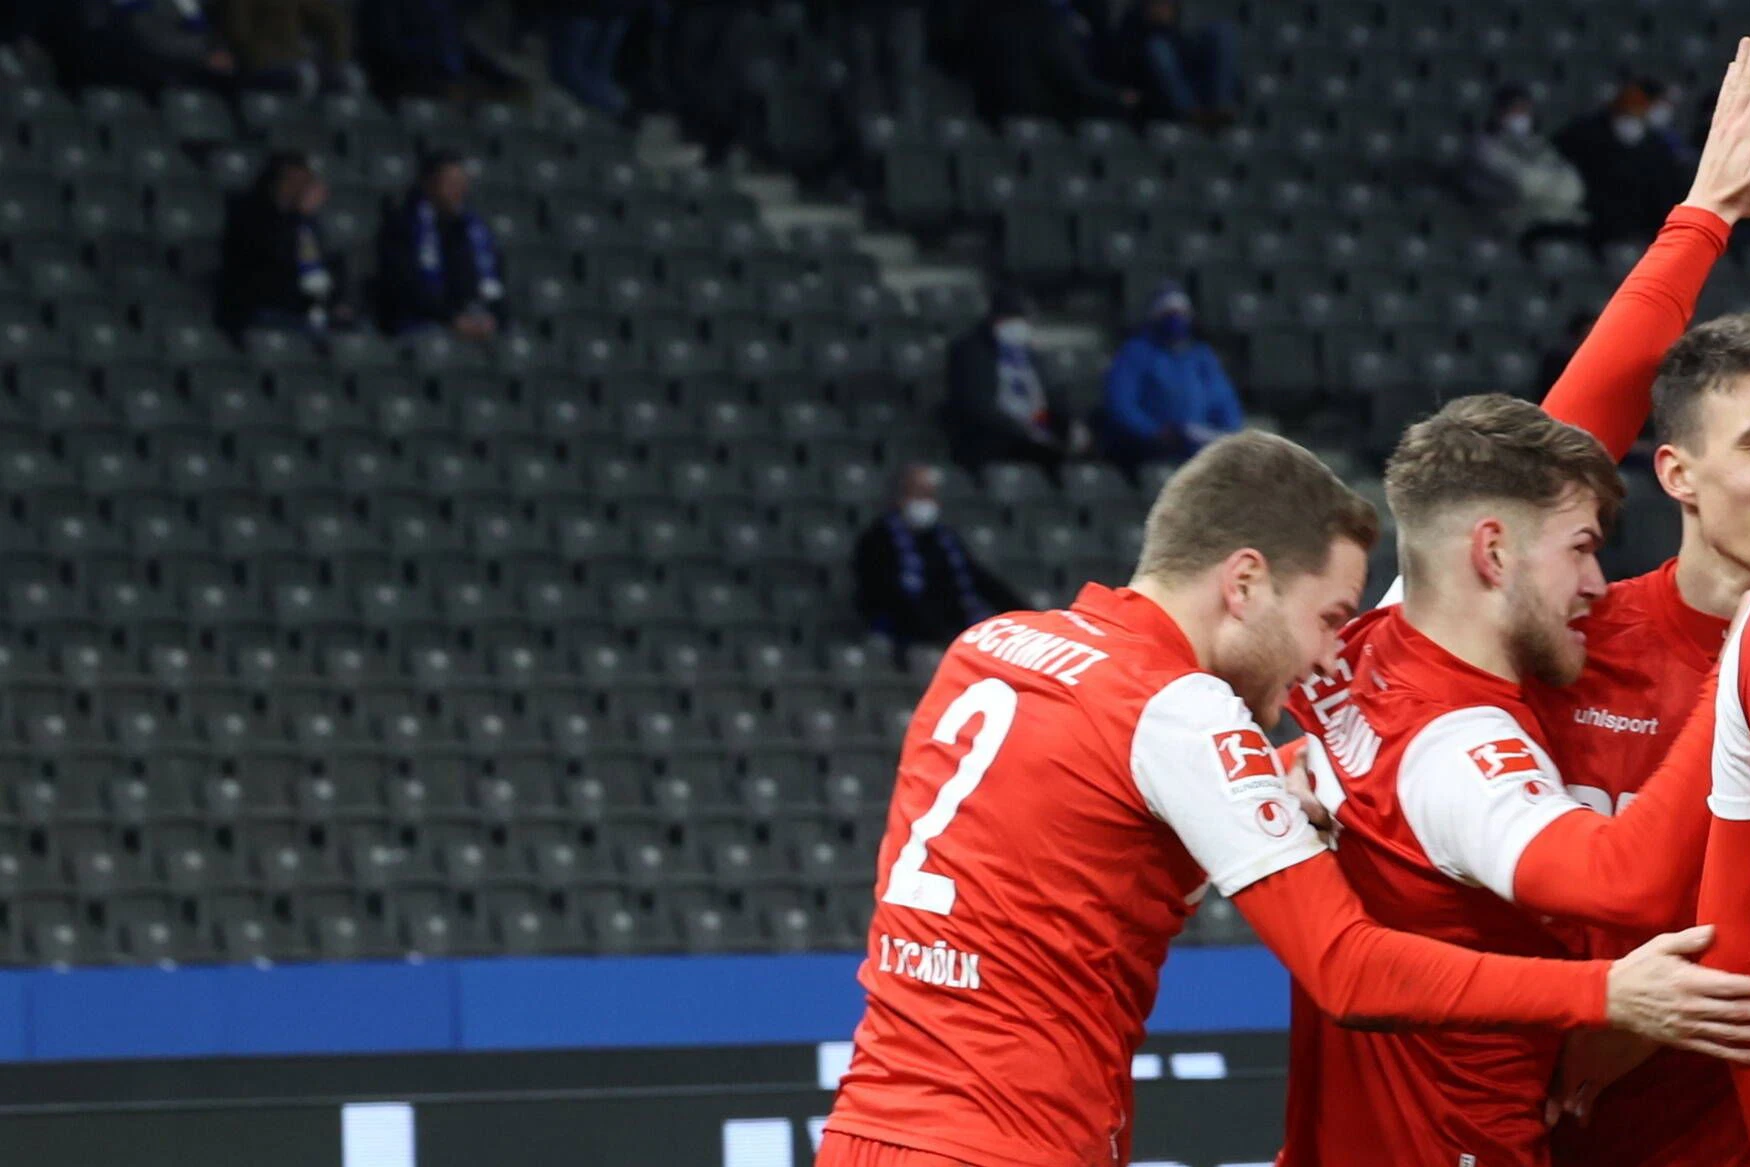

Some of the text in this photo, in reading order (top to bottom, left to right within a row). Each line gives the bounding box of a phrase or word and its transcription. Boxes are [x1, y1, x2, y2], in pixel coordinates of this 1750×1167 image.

[962, 618, 1110, 686] SCHMITZ
[1574, 707, 1659, 735] uhlsport
[883, 677, 1018, 916] 2
[916, 940, 980, 989] KÖLN
